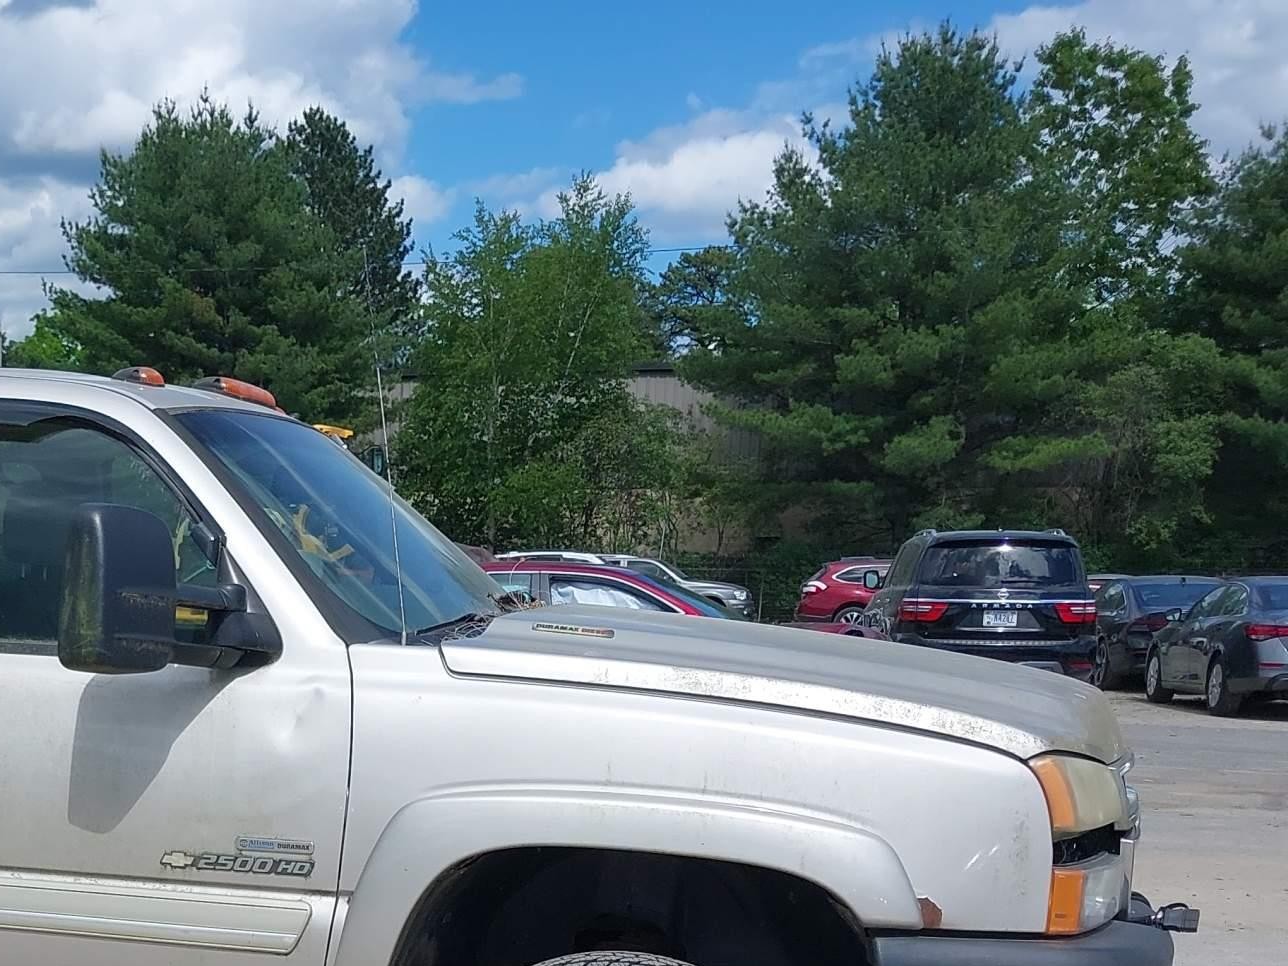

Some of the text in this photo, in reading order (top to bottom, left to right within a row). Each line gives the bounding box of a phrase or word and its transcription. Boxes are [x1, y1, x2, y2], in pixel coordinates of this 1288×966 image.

[536, 623, 579, 632] DURAMAX
[277, 843, 310, 851] DURAMAX
[198, 853, 312, 875] 2500 HD
